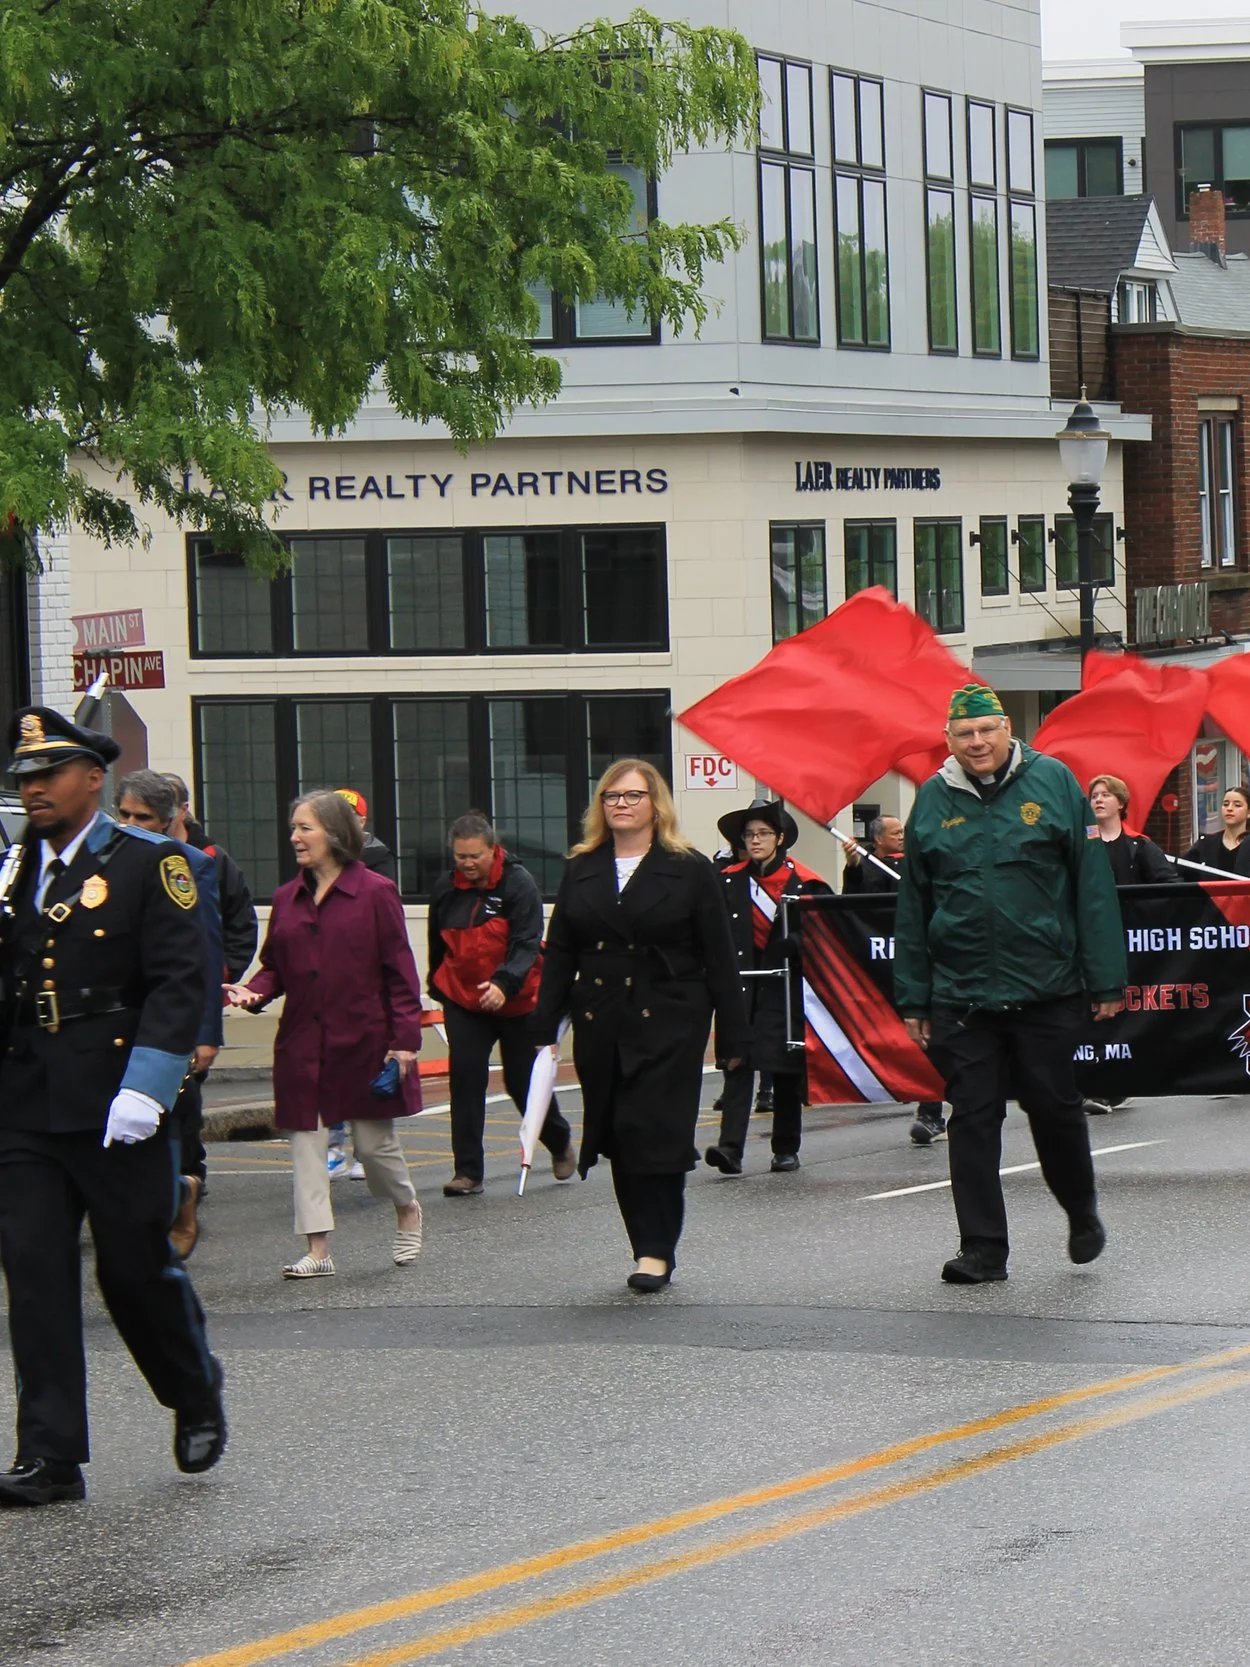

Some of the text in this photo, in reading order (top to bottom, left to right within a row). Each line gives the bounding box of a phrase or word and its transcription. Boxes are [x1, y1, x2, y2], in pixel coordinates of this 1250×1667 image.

[308, 474, 453, 500] REALTY
[470, 468, 669, 497] PARTNERS
[795, 461, 942, 491] LAER REALTY PARTNERS
[83, 613, 139, 646] MAIN ST
[73, 656, 162, 687] CHAPIN AVE
[690, 756, 732, 777] FDC
[1127, 927, 1182, 953] HIGH
[1092, 982, 1210, 1013] CKETS
[1105, 1043, 1133, 1060] MA
